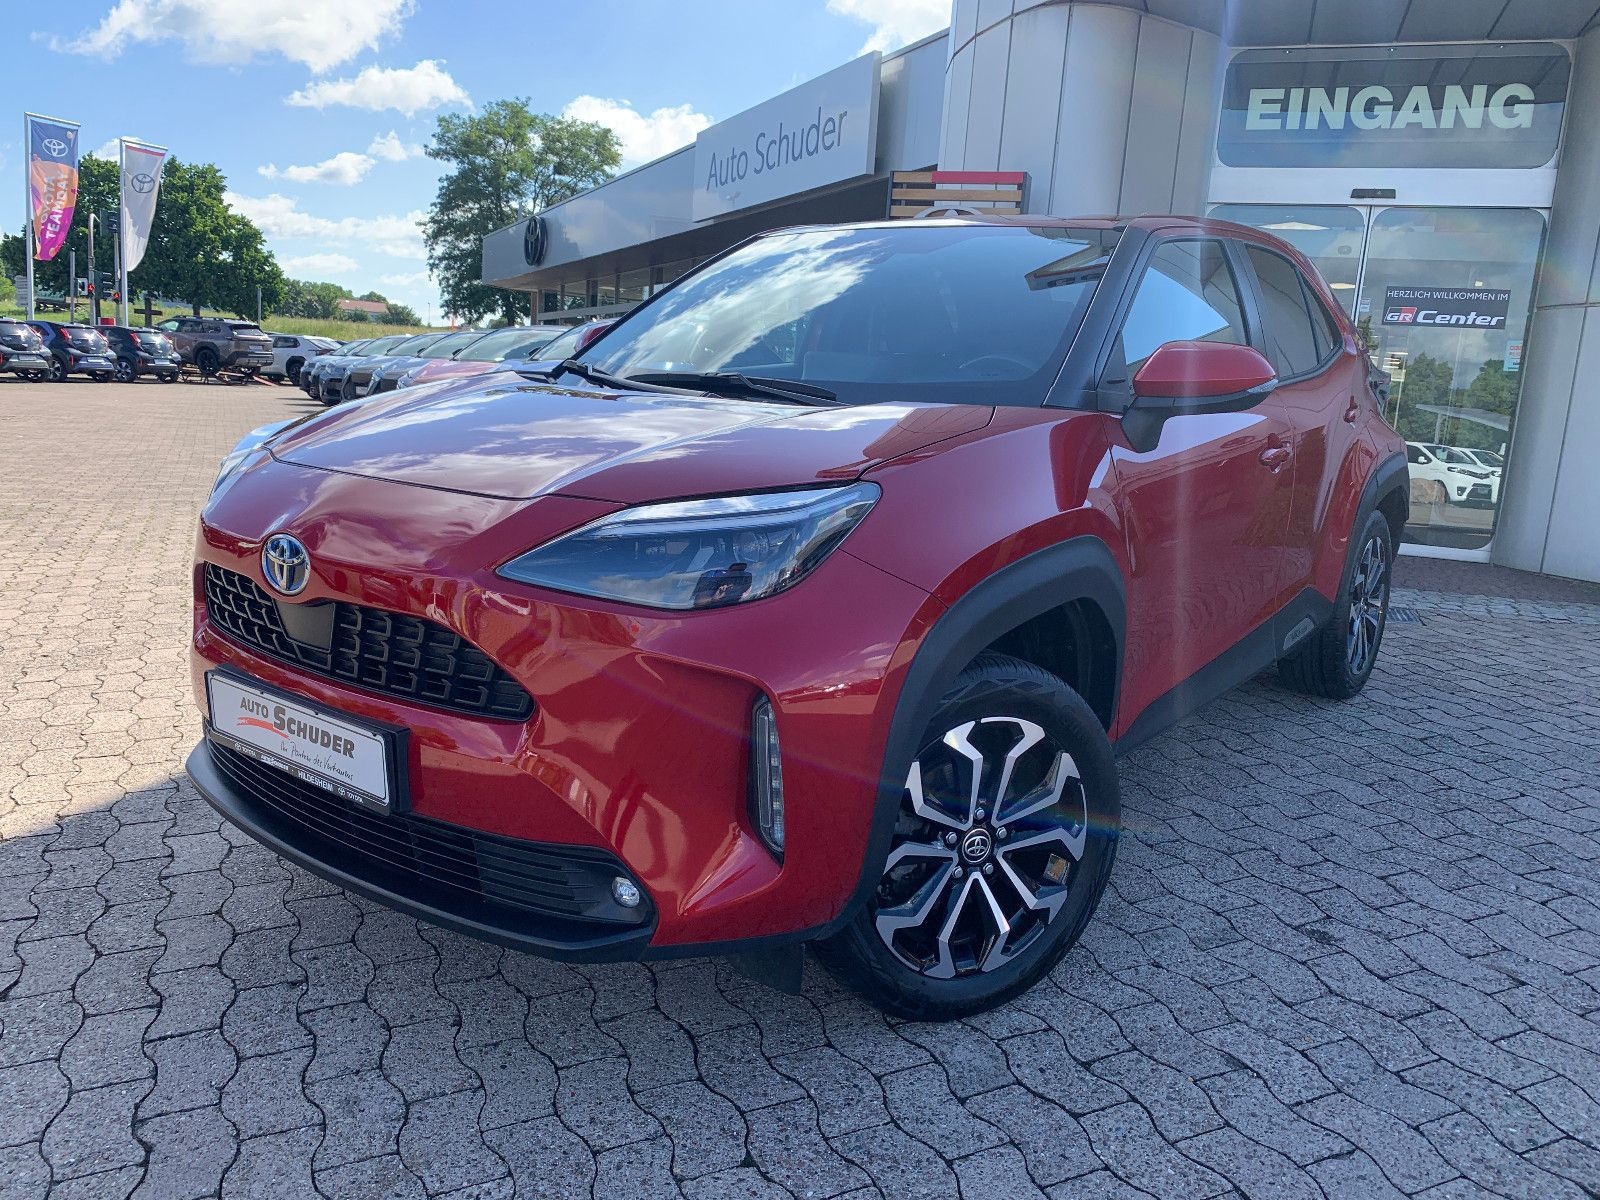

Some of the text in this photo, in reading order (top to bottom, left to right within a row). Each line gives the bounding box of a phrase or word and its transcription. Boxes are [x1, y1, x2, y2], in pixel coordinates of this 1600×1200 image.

[1245, 82, 1536, 131] EINGANG
[706, 106, 848, 191] Auto Schuder
[1387, 290, 1509, 301] HERZLICH WILLKOMMEN IM
[1385, 310, 1505, 326] GR Center
[240, 697, 355, 759] AUTO SCHUDER
[297, 769, 334, 792] HILDESHEIM
